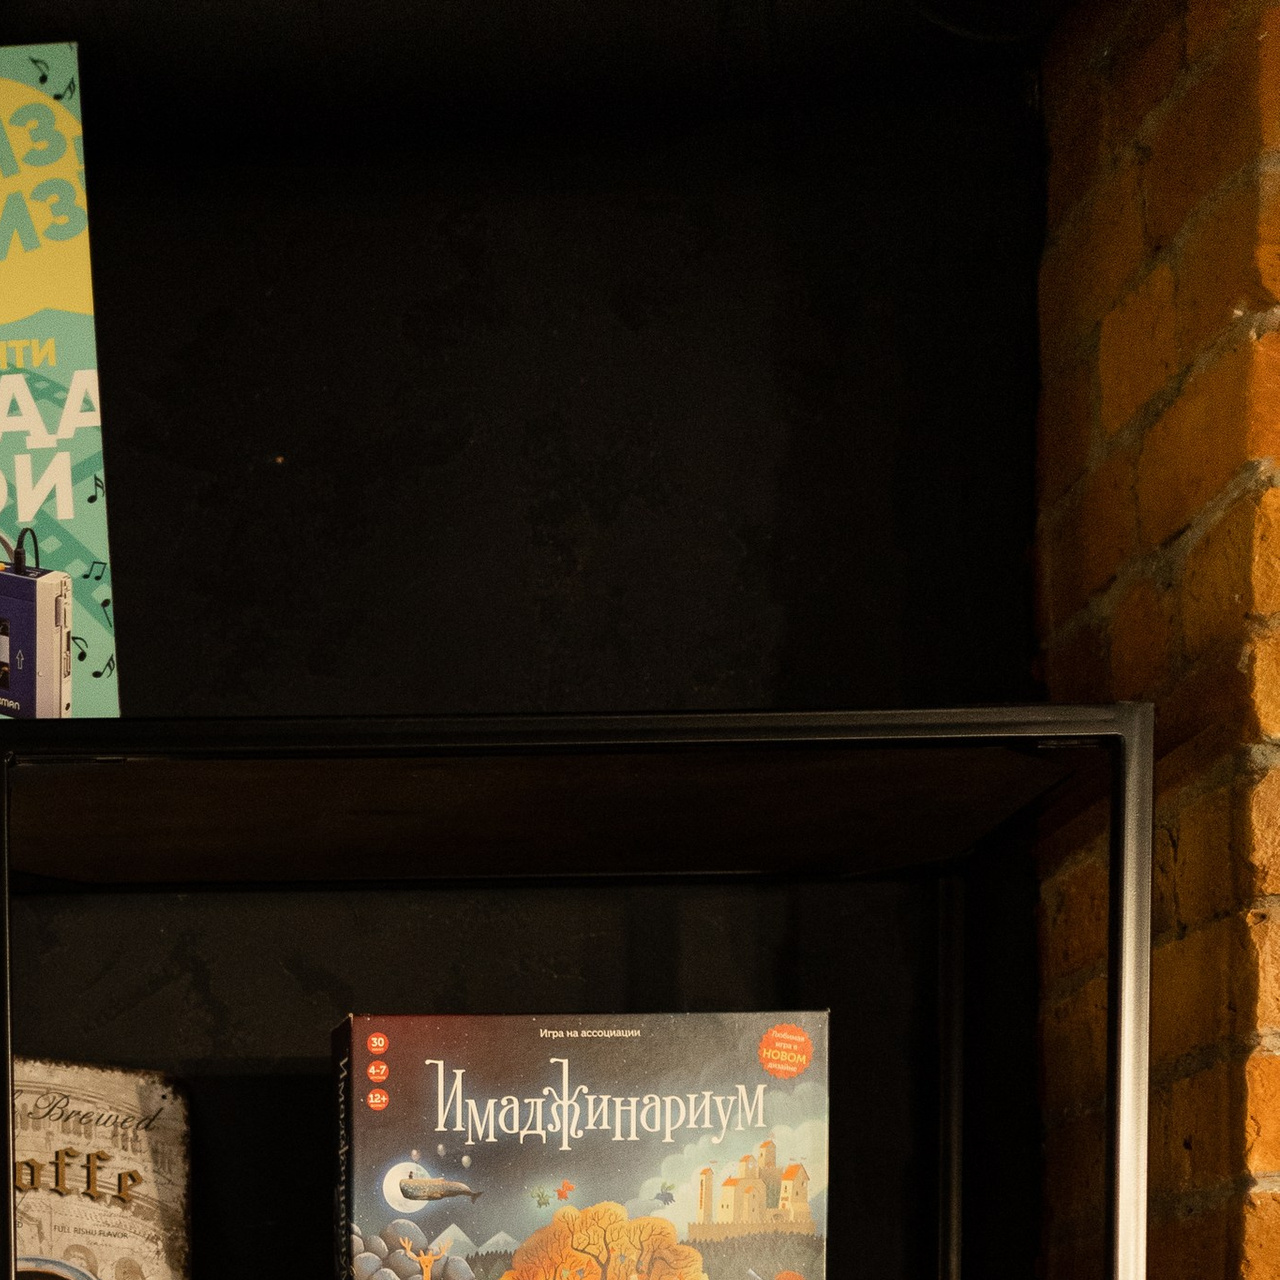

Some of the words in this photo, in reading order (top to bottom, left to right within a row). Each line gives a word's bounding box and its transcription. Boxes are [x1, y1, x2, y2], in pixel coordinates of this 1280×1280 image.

[539, 1028, 565, 1040] Игра
[566, 1030, 579, 1039] на
[580, 1028, 642, 1039] ассоциации
[371, 1037, 385, 1047] 30
[762, 1047, 807, 1065] НОВОМ
[369, 1065, 387, 1075] 4-7
[369, 1093, 388, 1103] 12+
[425, 1057, 768, 1151] Имаджинариум
[28, 1091, 164, 1132] Brewed
